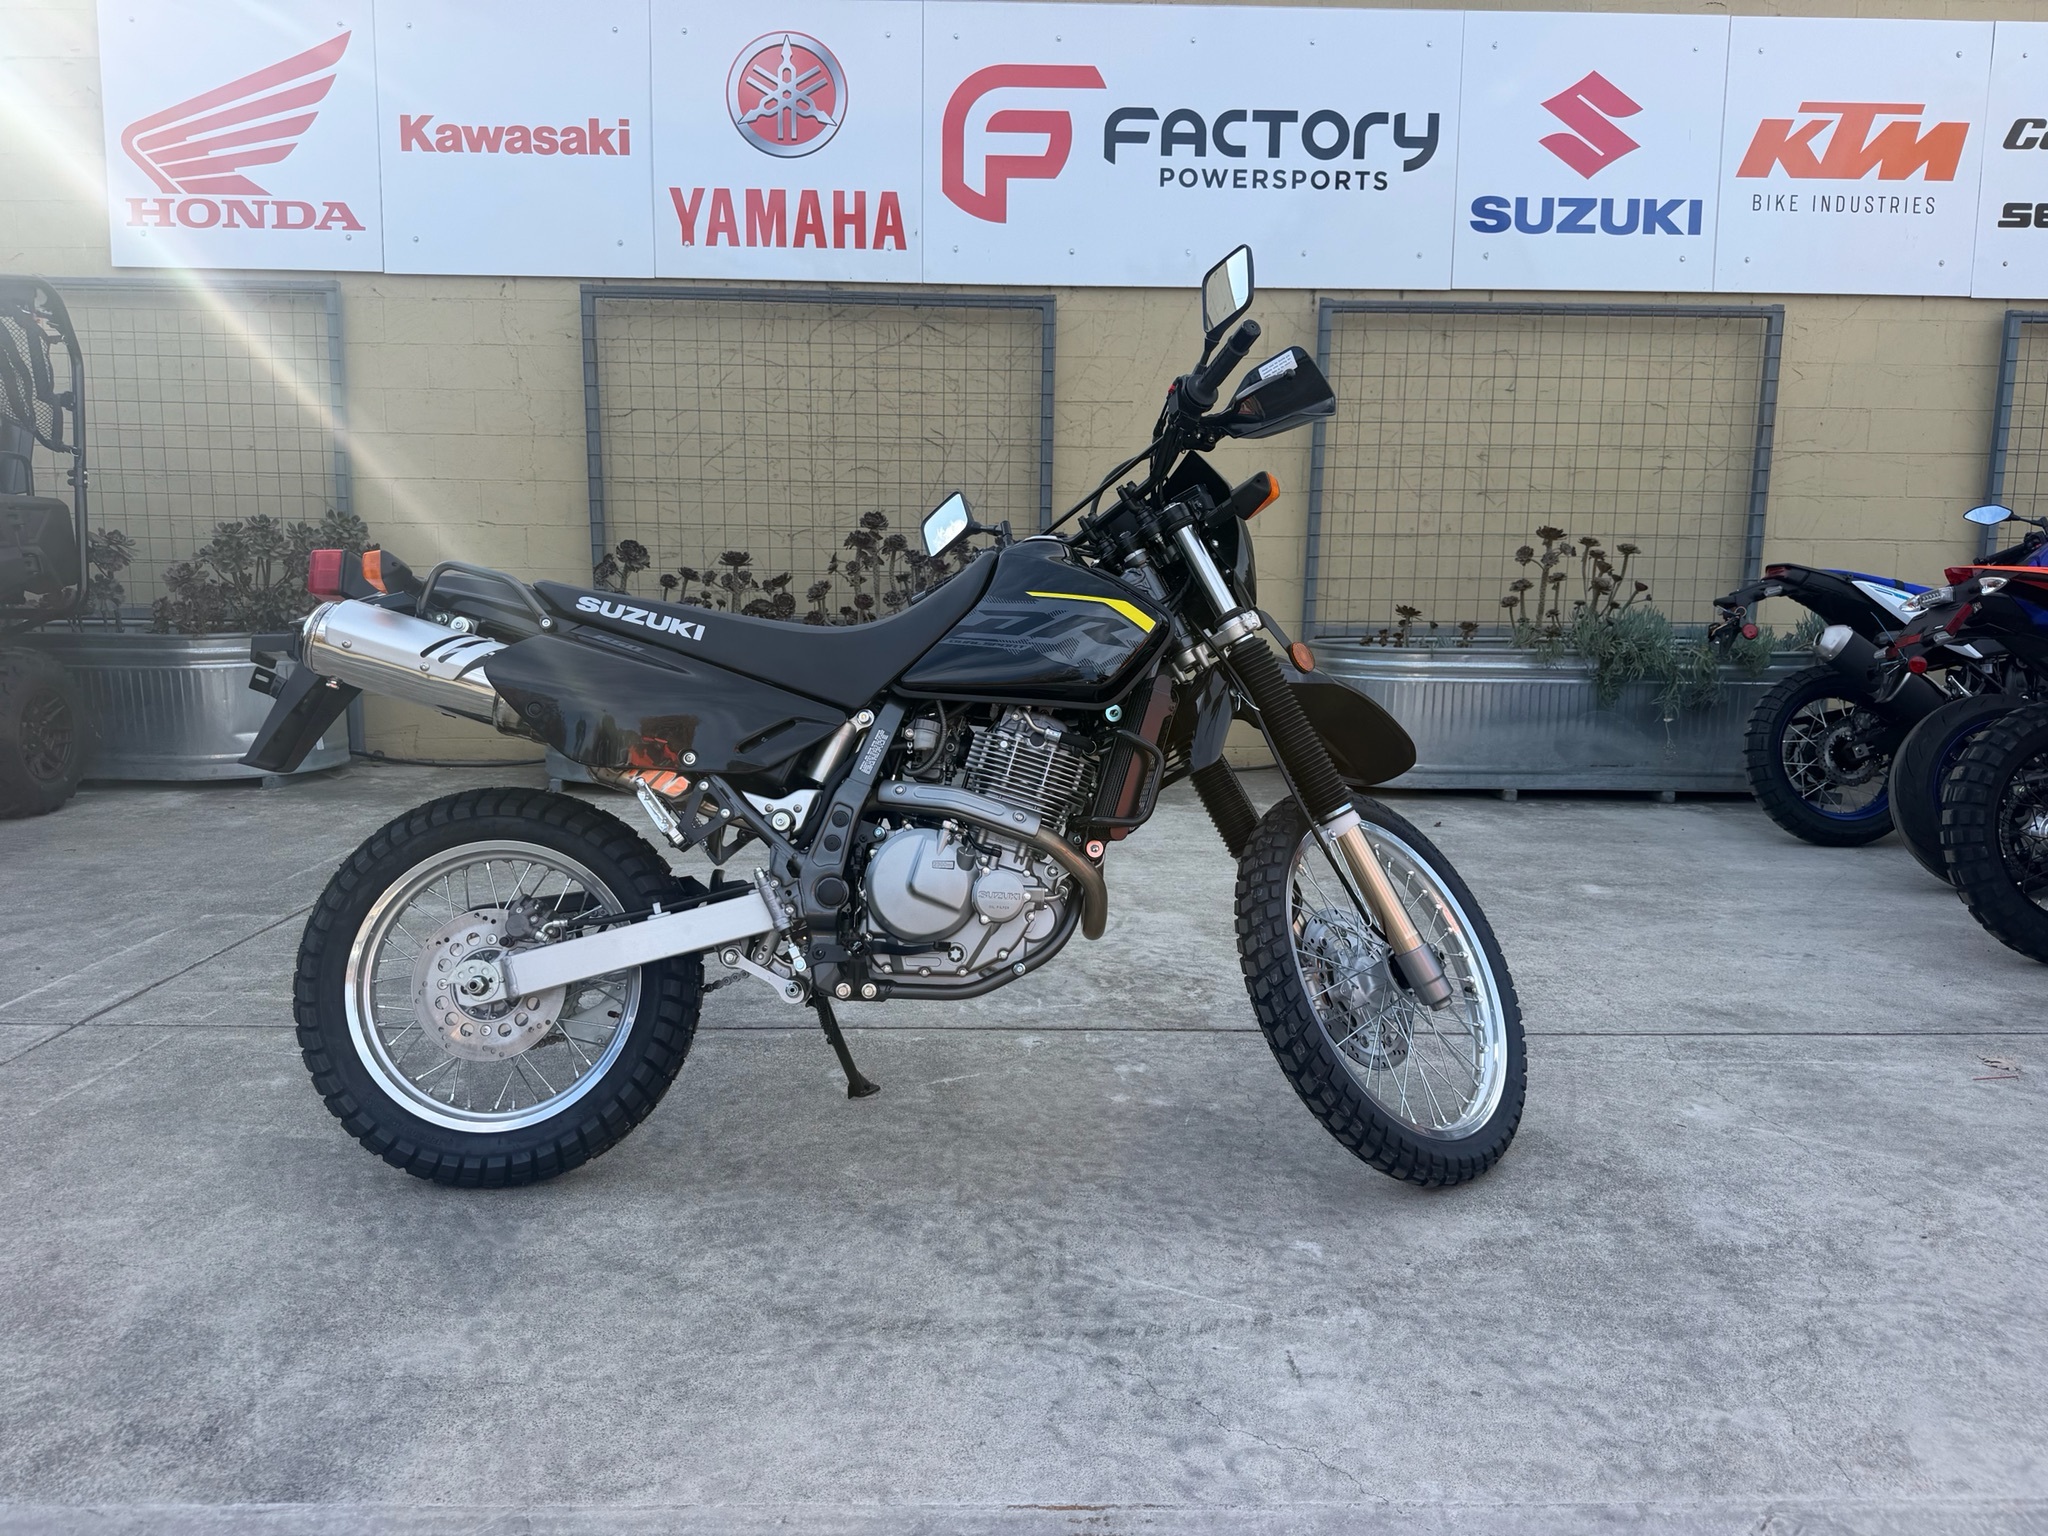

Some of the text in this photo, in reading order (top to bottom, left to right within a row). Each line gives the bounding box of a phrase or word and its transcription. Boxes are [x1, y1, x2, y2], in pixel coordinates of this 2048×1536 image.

[400, 114, 630, 156] Kawasaki
[1736, 102, 1970, 181] KTM
[1159, 167, 1388, 191] POWERSPORTS
[125, 197, 366, 231] HONDA
[669, 187, 907, 250] YAMAHA
[1469, 195, 1703, 236] SUZUKI
[1752, 194, 1935, 215] BIKE INDUSTRIES
[575, 596, 706, 641] SUZUKI
[977, 890, 1021, 901] SUZUKI
